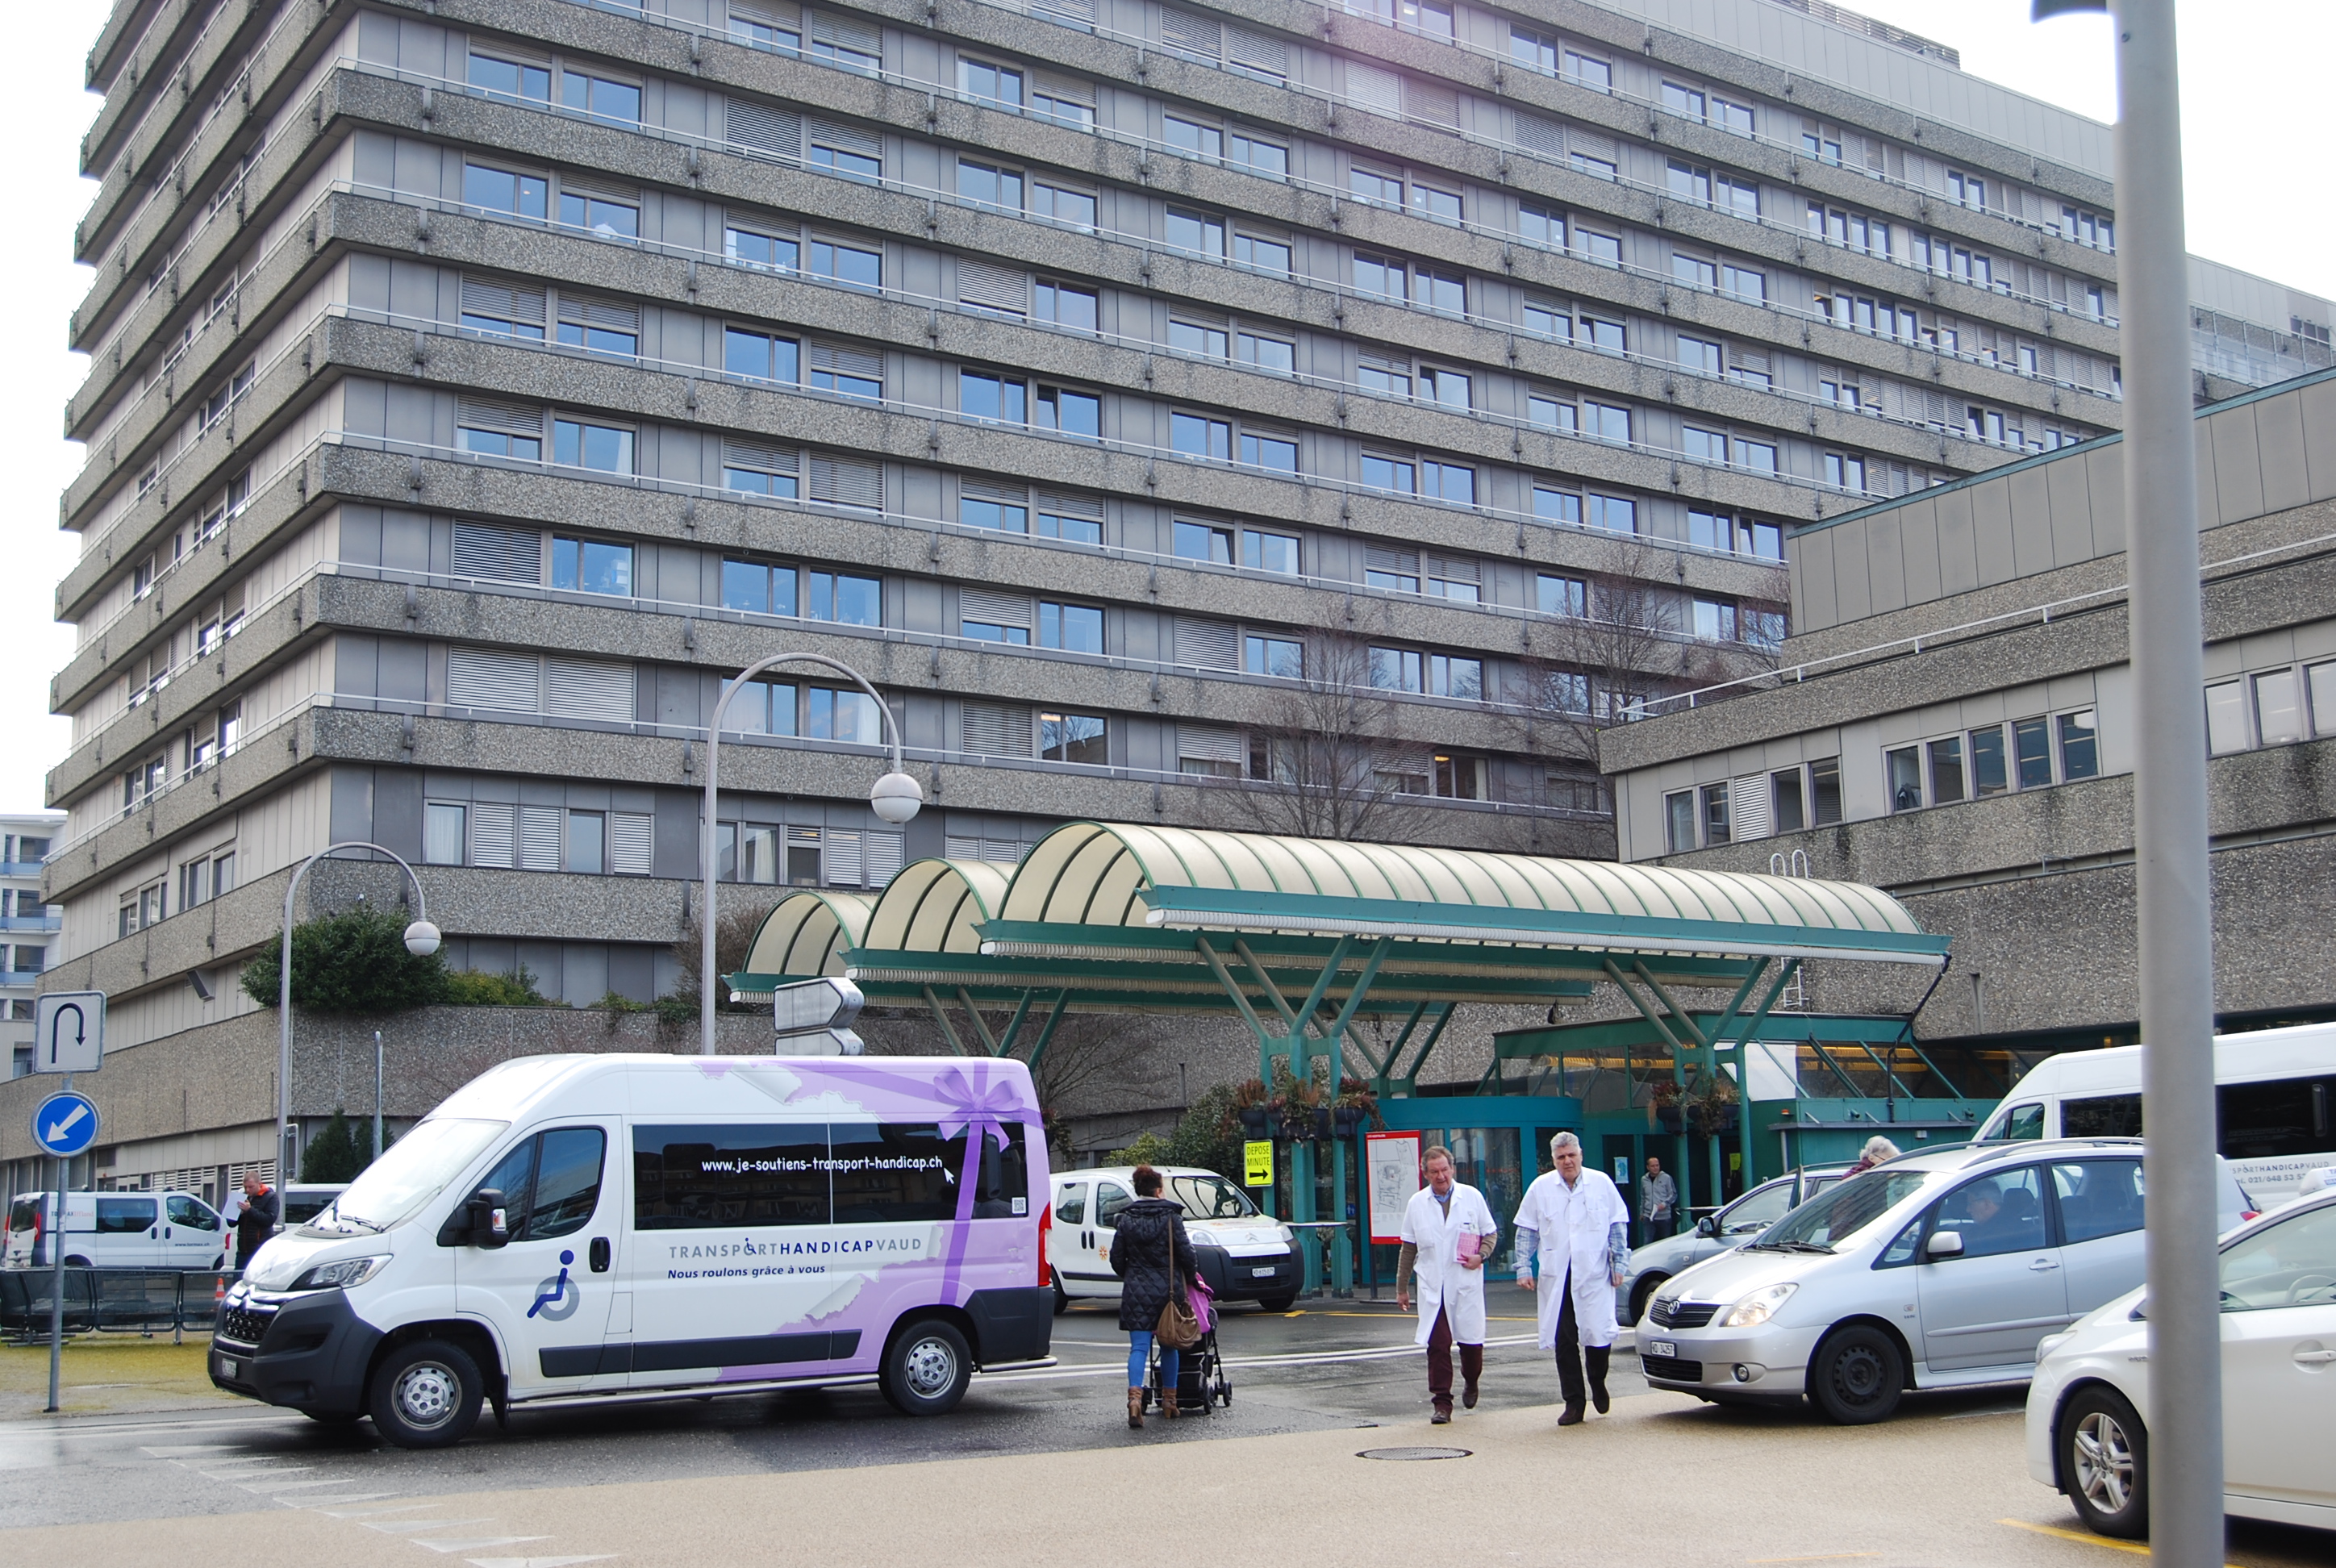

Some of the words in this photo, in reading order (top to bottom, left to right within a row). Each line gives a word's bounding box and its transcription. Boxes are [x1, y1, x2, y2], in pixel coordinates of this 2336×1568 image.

[1247, 1145, 1270, 1155] DEPOSE
[702, 1156, 943, 1174] www.je-soutiens-transport-handicap.ch
[1247, 1157, 1270, 1166] MINUTE
[2248, 1174, 2282, 1184] 021/648
[668, 1270, 699, 1279] Nous
[702, 1267, 749, 1278] roulons
[752, 1266, 784, 1278] grâce
[787, 1265, 795, 1274] à
[798, 1266, 826, 1274] vous
